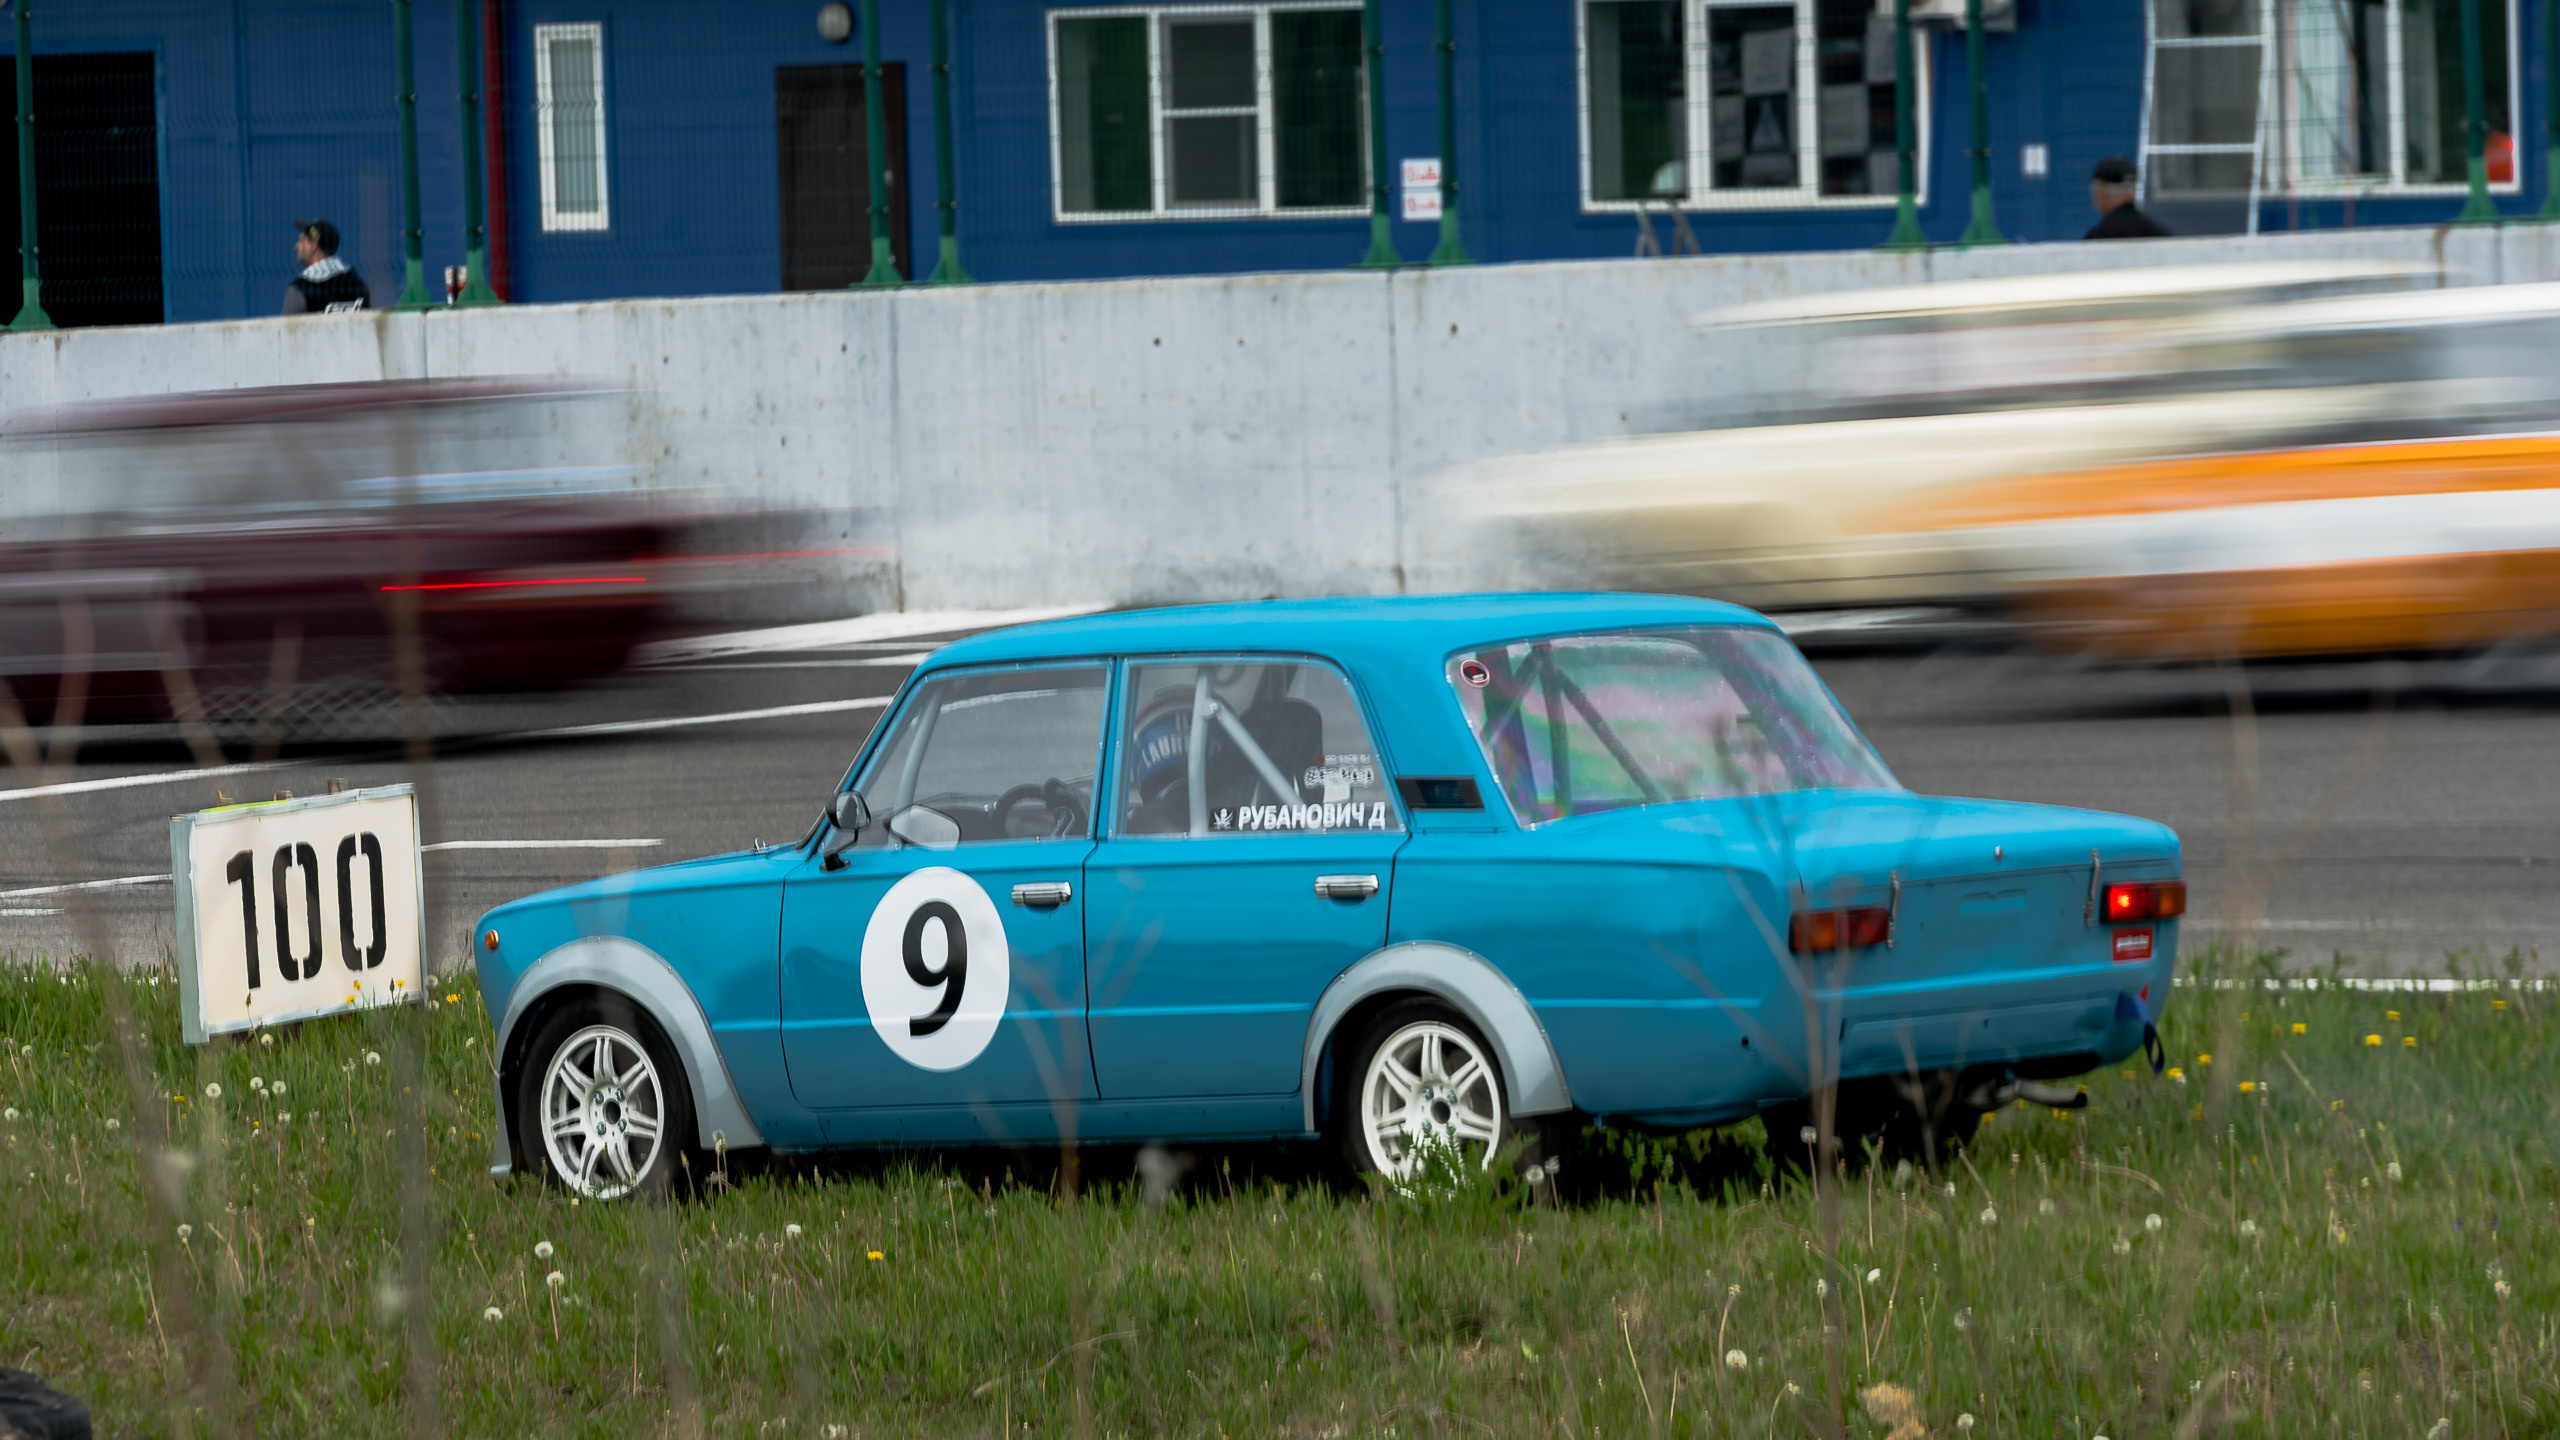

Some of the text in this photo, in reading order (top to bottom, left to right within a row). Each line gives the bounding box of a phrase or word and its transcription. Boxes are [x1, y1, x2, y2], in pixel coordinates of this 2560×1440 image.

[1238, 801, 1386, 831] РУБАНОВИЧ Д
[226, 830, 387, 990] 100
[902, 899, 968, 1037] 9
